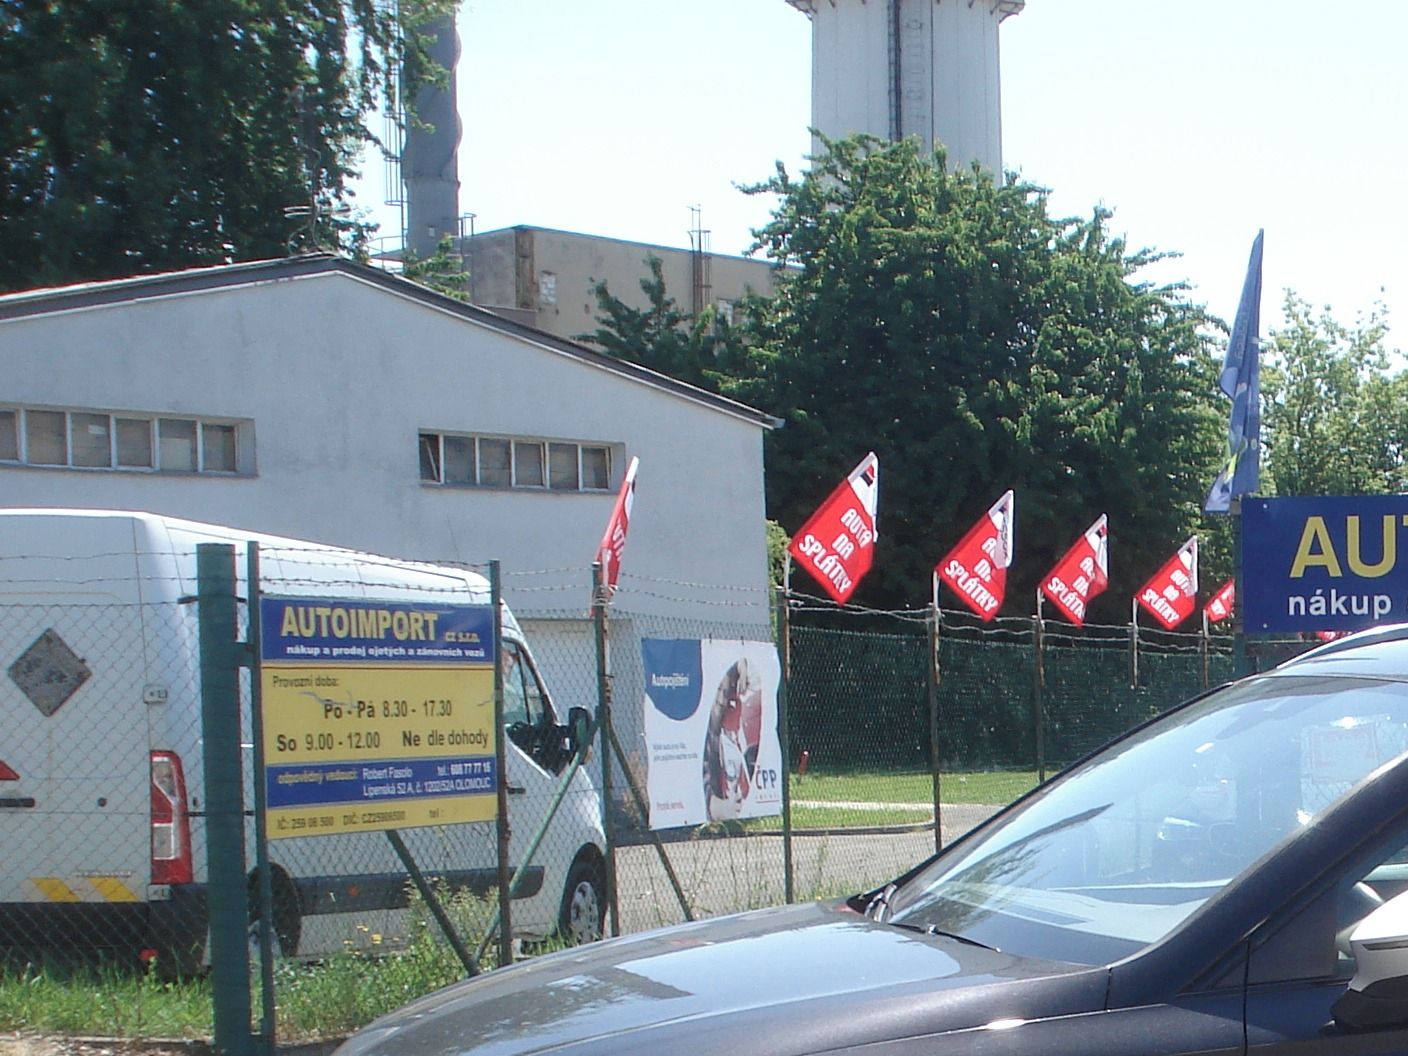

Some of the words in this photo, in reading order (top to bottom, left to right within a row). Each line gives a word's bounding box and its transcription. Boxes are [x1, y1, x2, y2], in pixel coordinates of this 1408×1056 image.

[839, 508, 874, 549] AUTA
[831, 532, 855, 561] NA
[798, 534, 853, 594] SPLÁTKY
[944, 559, 999, 613] SPLÁTKY
[1288, 588, 1393, 620] nákup
[281, 606, 439, 641] AUTOIMPORT
[286, 645, 321, 657] nákup
[322, 647, 331, 655] a
[332, 645, 367, 657] prodej
[407, 648, 415, 656] a
[272, 674, 313, 688] Provozní
[323, 699, 344, 719] Po
[357, 700, 376, 719] Pá
[382, 700, 408, 718] 8.30
[422, 699, 453, 717] 17.30
[276, 733, 297, 752] So
[305, 733, 334, 751] 9.00
[347, 731, 381, 749] 12.00
[402, 729, 421, 747] Ne
[427, 729, 445, 746] dle
[447, 728, 489, 749] dohody
[755, 766, 778, 790] ČPP
